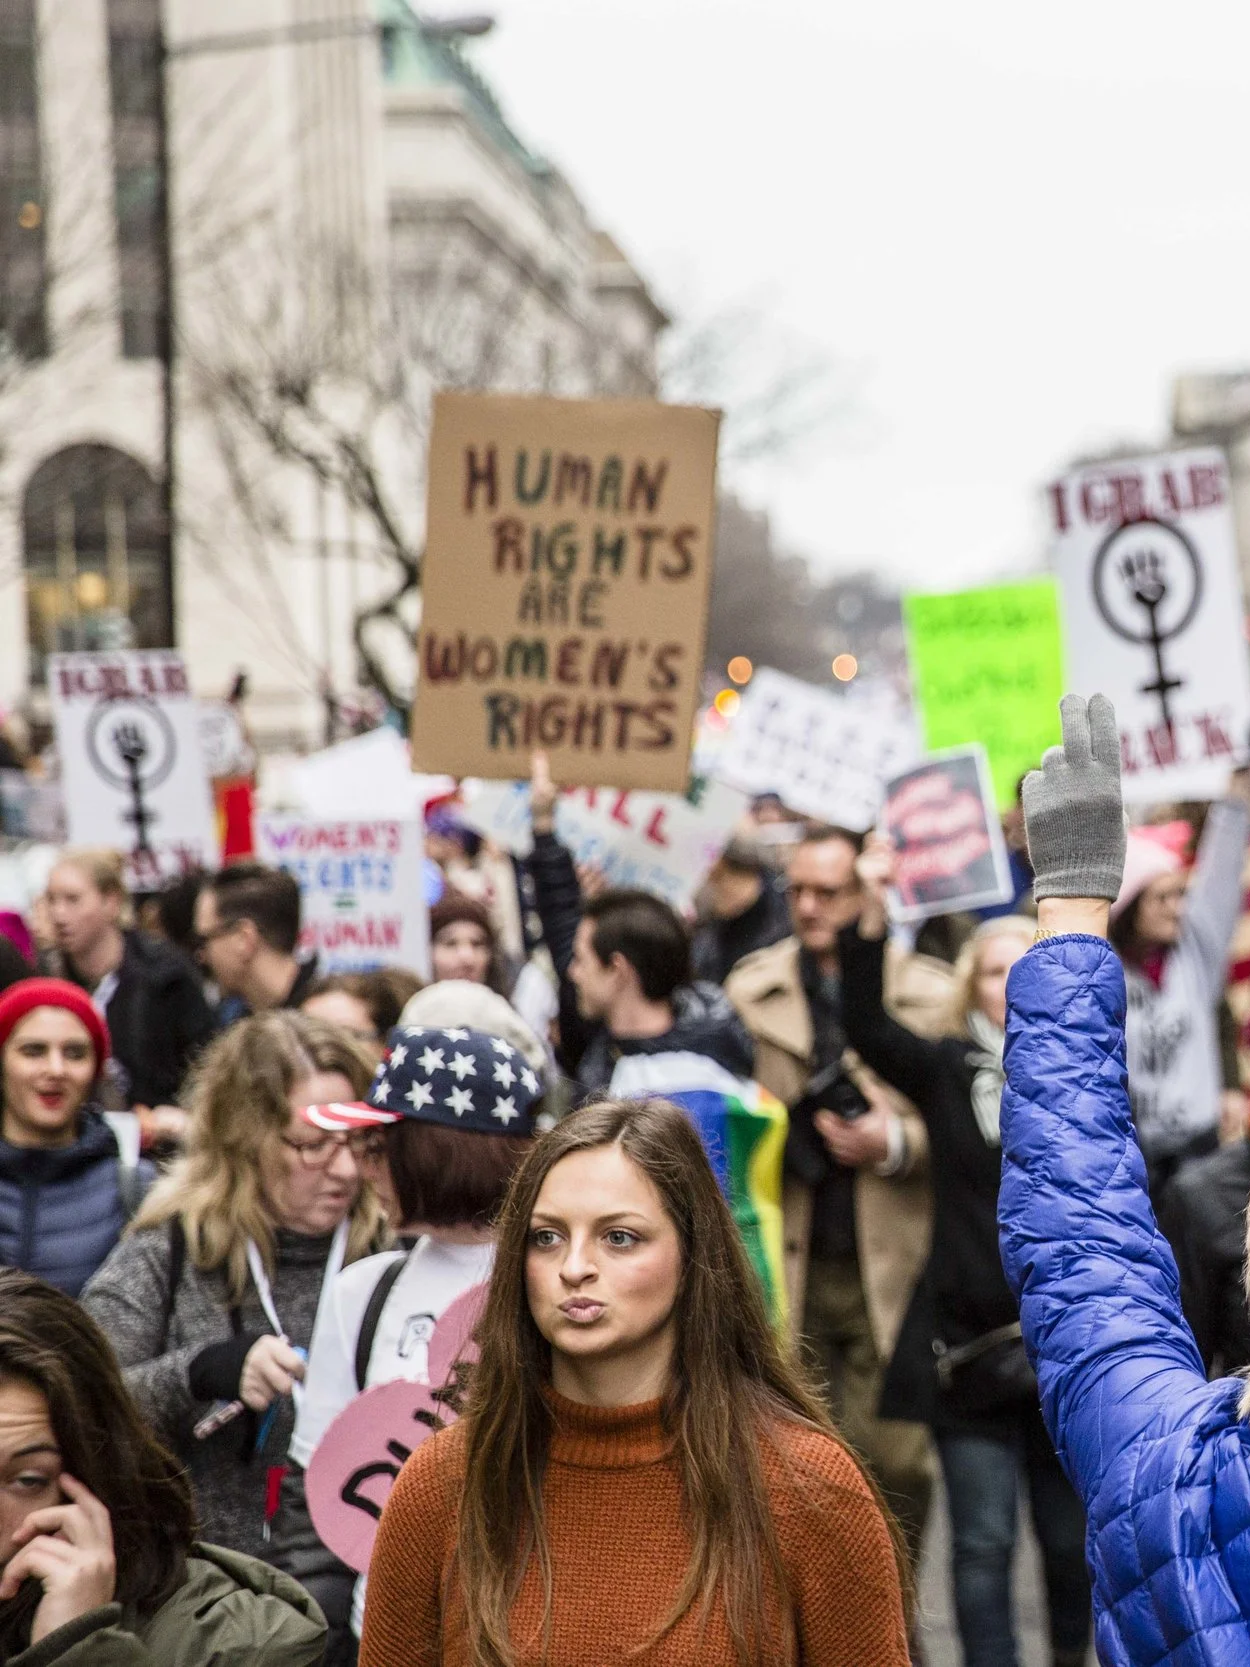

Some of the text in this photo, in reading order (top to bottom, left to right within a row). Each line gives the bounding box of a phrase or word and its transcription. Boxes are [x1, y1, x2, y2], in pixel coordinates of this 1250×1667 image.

[465, 441, 669, 515] HUMAN
[491, 516, 698, 584] RIGHTS
[516, 578, 608, 630] ARE
[424, 629, 682, 693] WOMEN'S
[486, 690, 677, 754] RIGHTS
